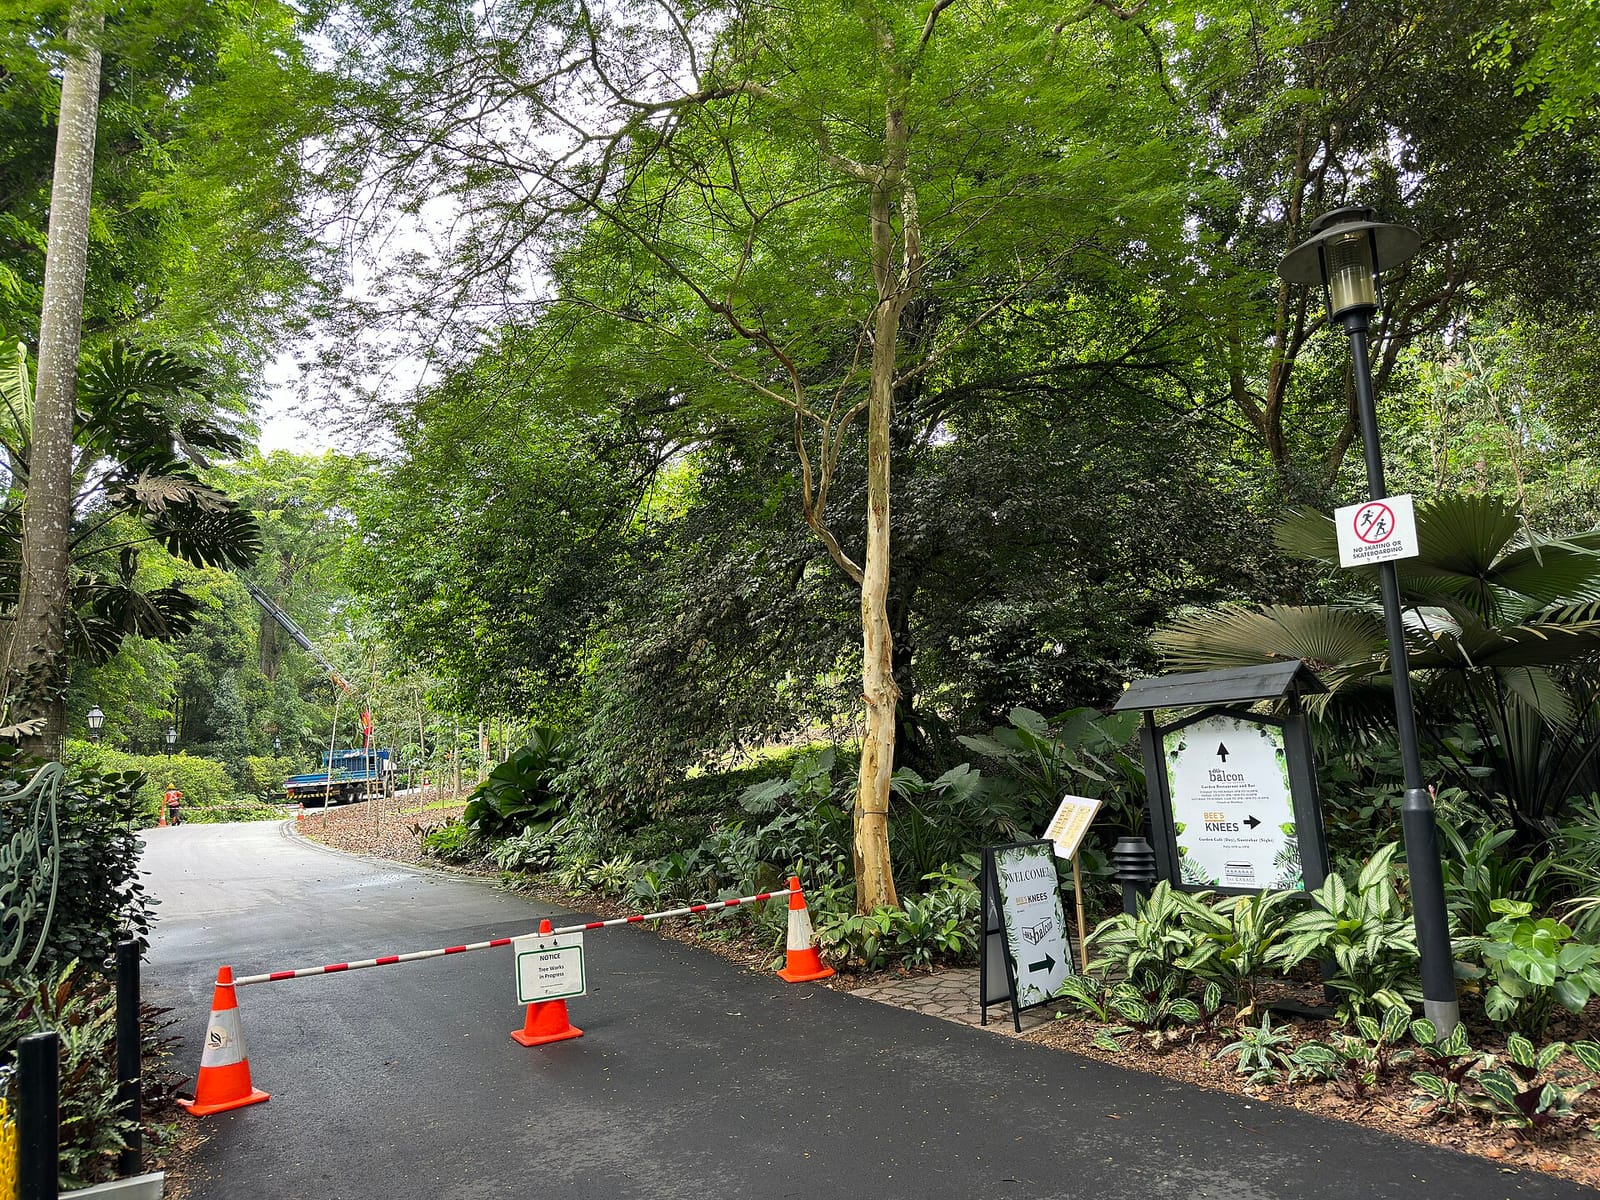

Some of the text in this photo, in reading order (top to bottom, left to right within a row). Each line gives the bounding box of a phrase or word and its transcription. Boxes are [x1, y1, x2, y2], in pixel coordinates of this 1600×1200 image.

[1364, 542, 1391, 551] SKATING
[1352, 546, 1404, 559] SKATEBOARDING
[1208, 769, 1244, 782] balcon
[1205, 822, 1239, 832] KNEES
[1027, 892, 1048, 903] KNEES
[539, 953, 561, 961] NOTICE
